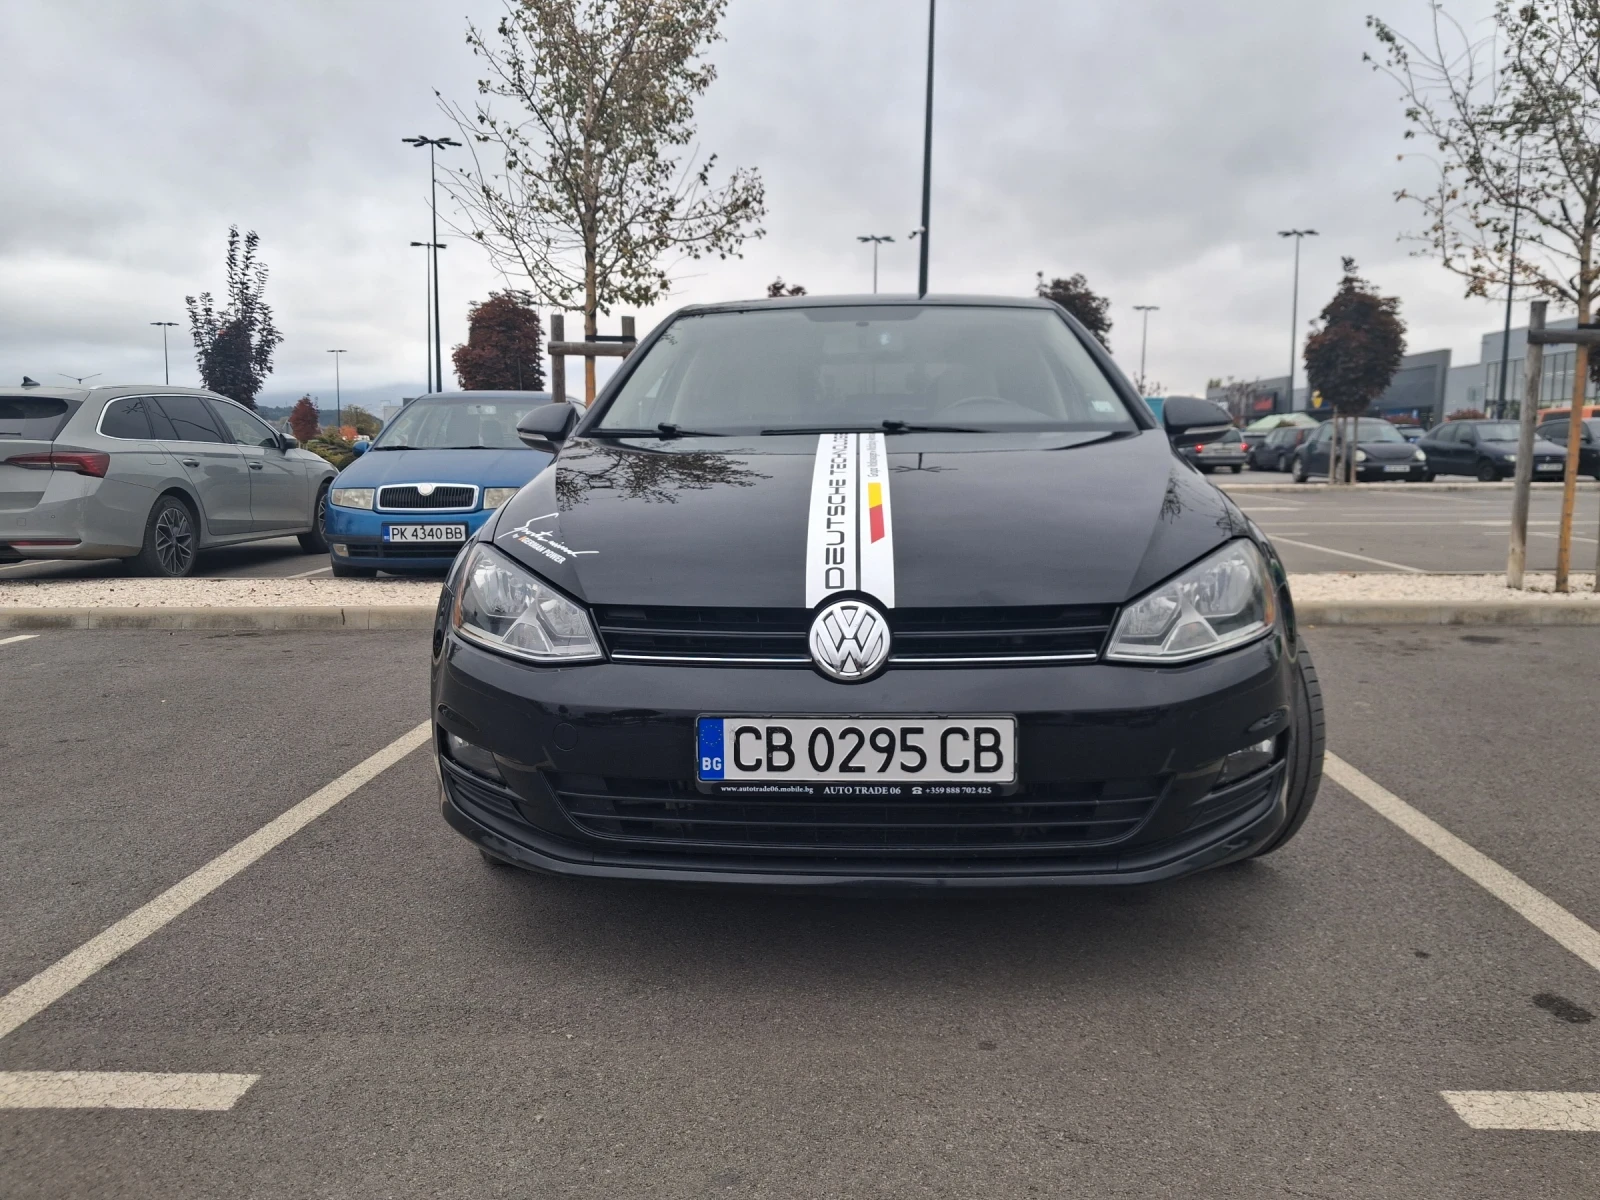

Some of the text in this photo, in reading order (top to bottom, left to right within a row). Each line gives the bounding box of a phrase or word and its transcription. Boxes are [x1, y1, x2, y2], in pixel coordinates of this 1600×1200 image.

[391, 527, 463, 541] PK 4340 BB
[824, 479, 847, 590] DEUTSCHE
[542, 548, 567, 565] POWER
[733, 725, 1004, 774] CB 0295 CB
[702, 757, 722, 771] BG
[720, 785, 814, 794] www.autotrade06.mobile.bg
[823, 786, 901, 795] AUTO TRADE 06
[925, 786, 992, 795] +359 888 702 425
